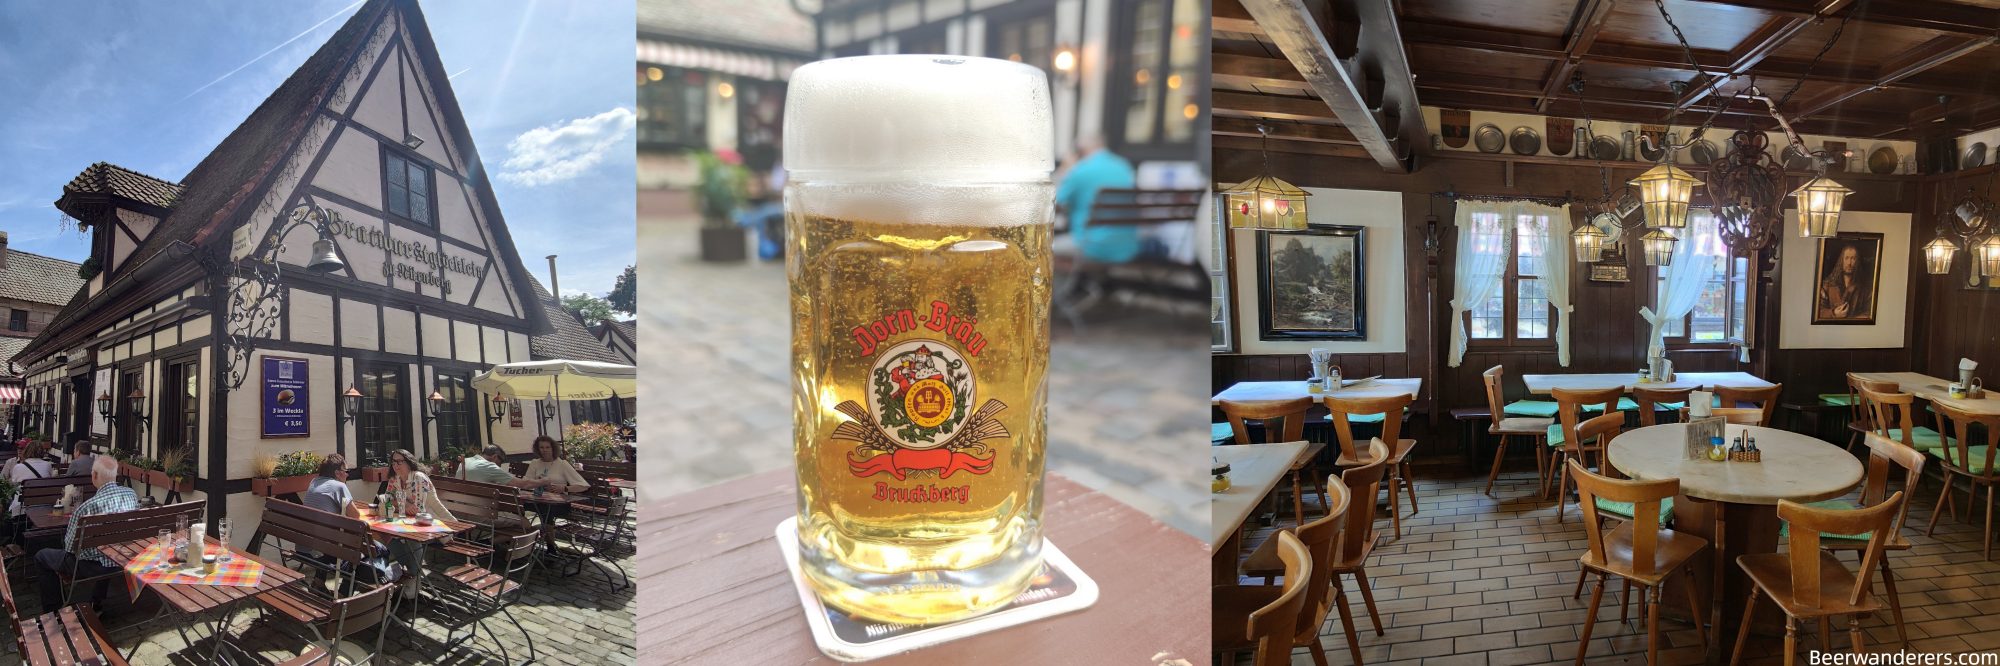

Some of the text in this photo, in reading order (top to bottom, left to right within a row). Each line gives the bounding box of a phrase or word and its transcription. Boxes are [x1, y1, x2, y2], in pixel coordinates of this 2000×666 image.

[397, 262, 452, 295] Nürnberg
[852, 300, 988, 358] Dorn-Bräu
[503, 366, 543, 375] Tucher
[872, 482, 970, 505] Bruckberg
